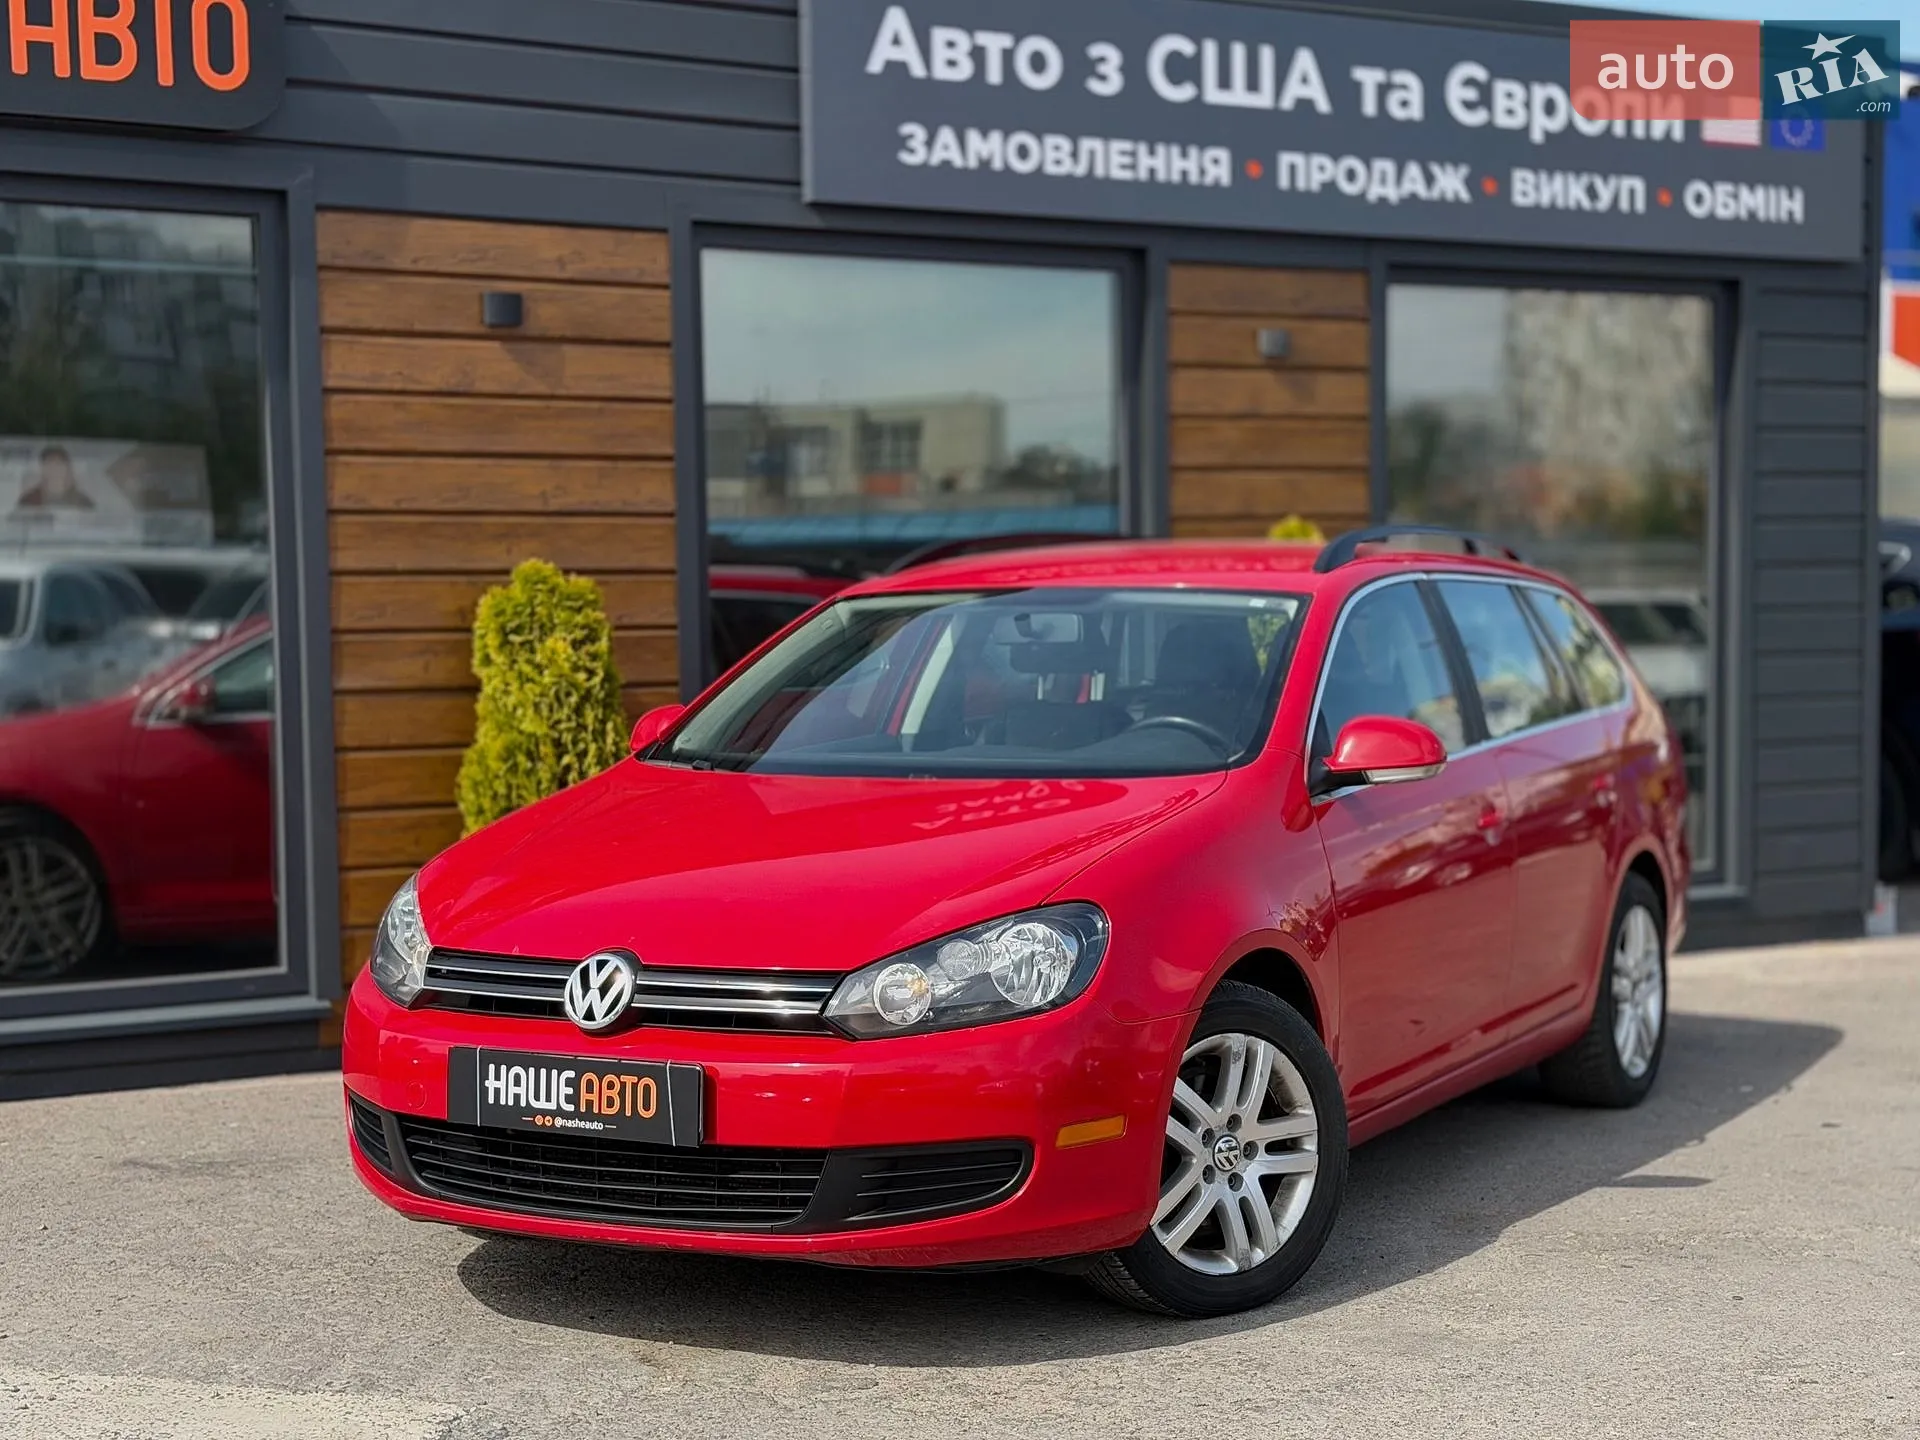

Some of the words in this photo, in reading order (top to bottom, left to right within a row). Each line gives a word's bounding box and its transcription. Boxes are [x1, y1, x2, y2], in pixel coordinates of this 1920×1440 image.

[865, 5, 1064, 91] Авто
[1085, 42, 1125, 97] з
[1147, 33, 1333, 115] США
[1352, 65, 1424, 122] та
[1444, 60, 1685, 143] Європи
[896, 122, 1232, 187] ЗАМОВЛЕННЯ
[1277, 151, 1472, 206] ПРОДАЖ
[1510, 167, 1646, 213] ВИКУП
[1683, 180, 1805, 224] ОБМІН
[565, 954, 632, 1028] VW
[485, 1063, 576, 1112] НАШЕ
[580, 1072, 657, 1118] АВТО
[554, 1116, 604, 1130] @nasheauto
